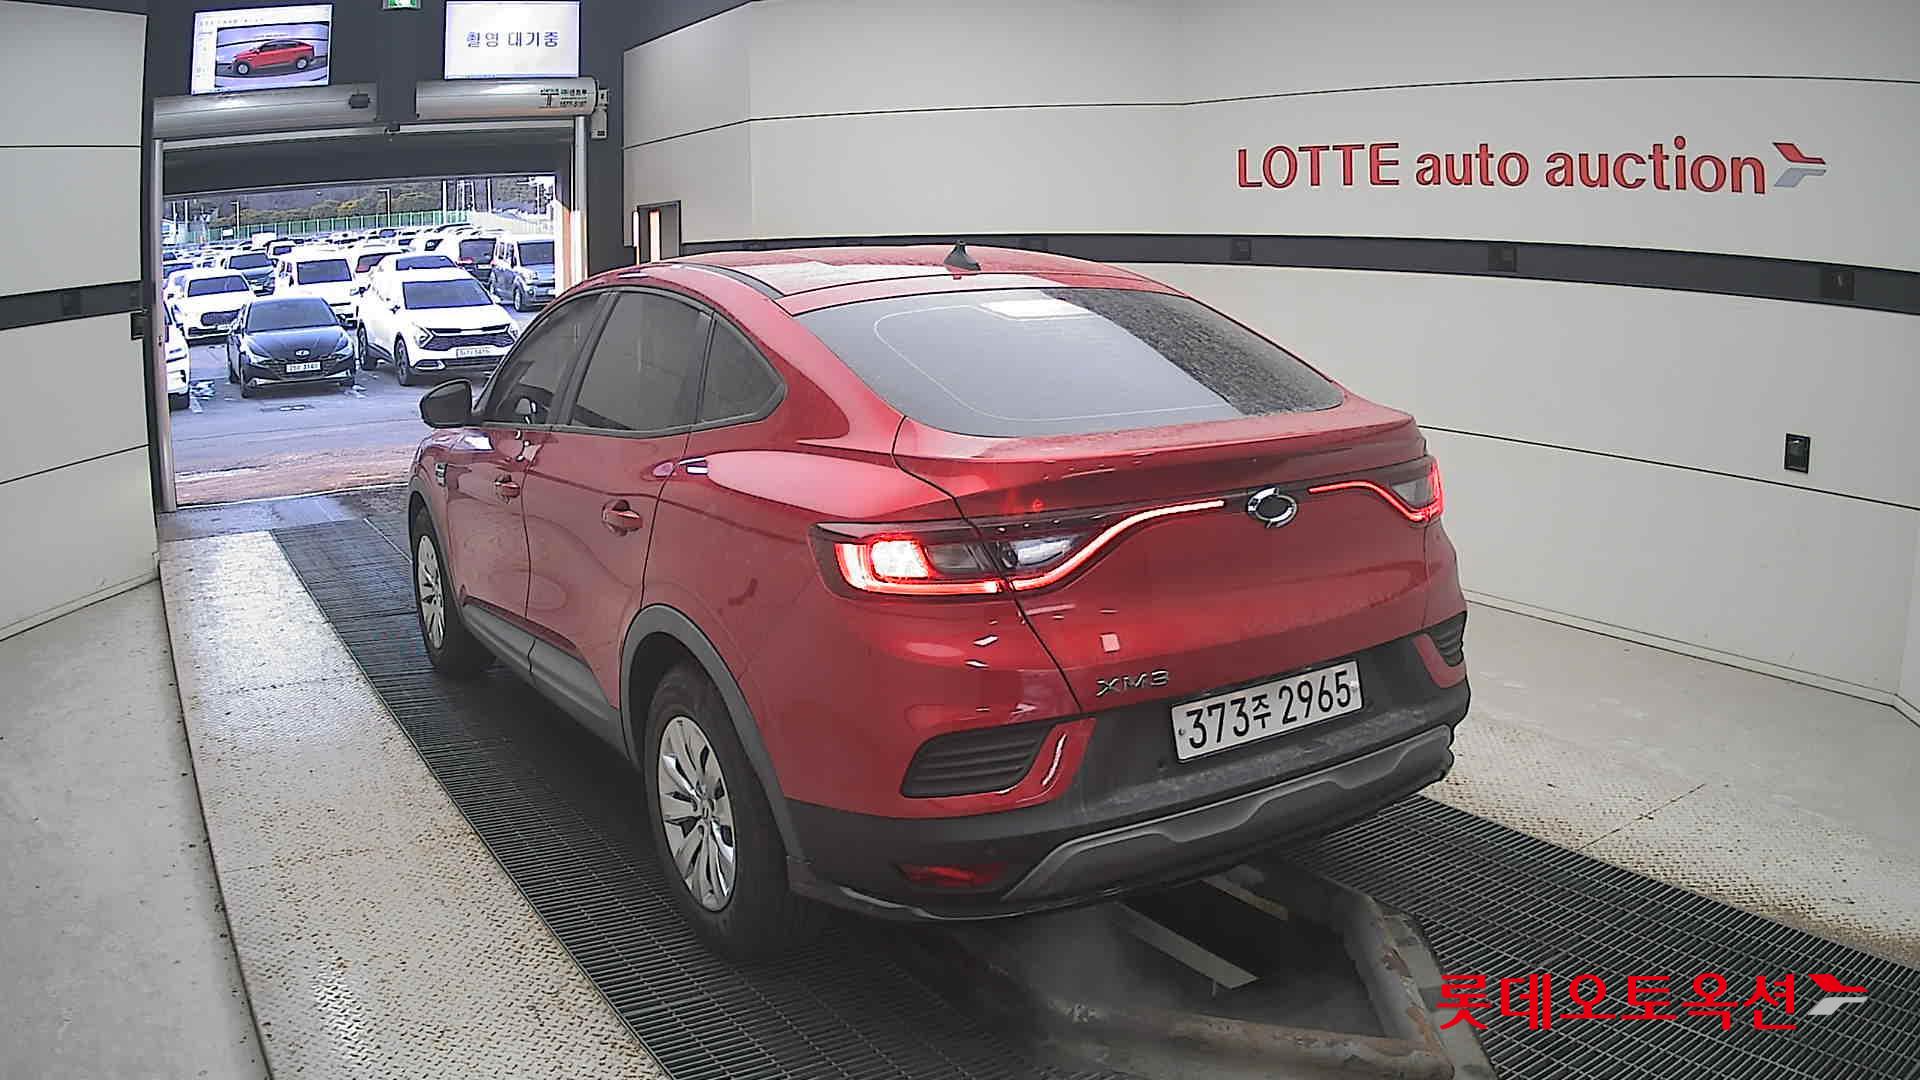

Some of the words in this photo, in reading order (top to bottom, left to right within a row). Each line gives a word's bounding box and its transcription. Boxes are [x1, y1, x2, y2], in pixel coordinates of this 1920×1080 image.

[508, 31, 560, 48] 대기중
[1236, 142, 1400, 188] LOTTE
[1415, 143, 1530, 188] auto
[1545, 136, 1765, 194] auction
[1095, 669, 1170, 697] XM3
[1186, 694, 1271, 749] 373주
[1278, 670, 1350, 725] 2965
